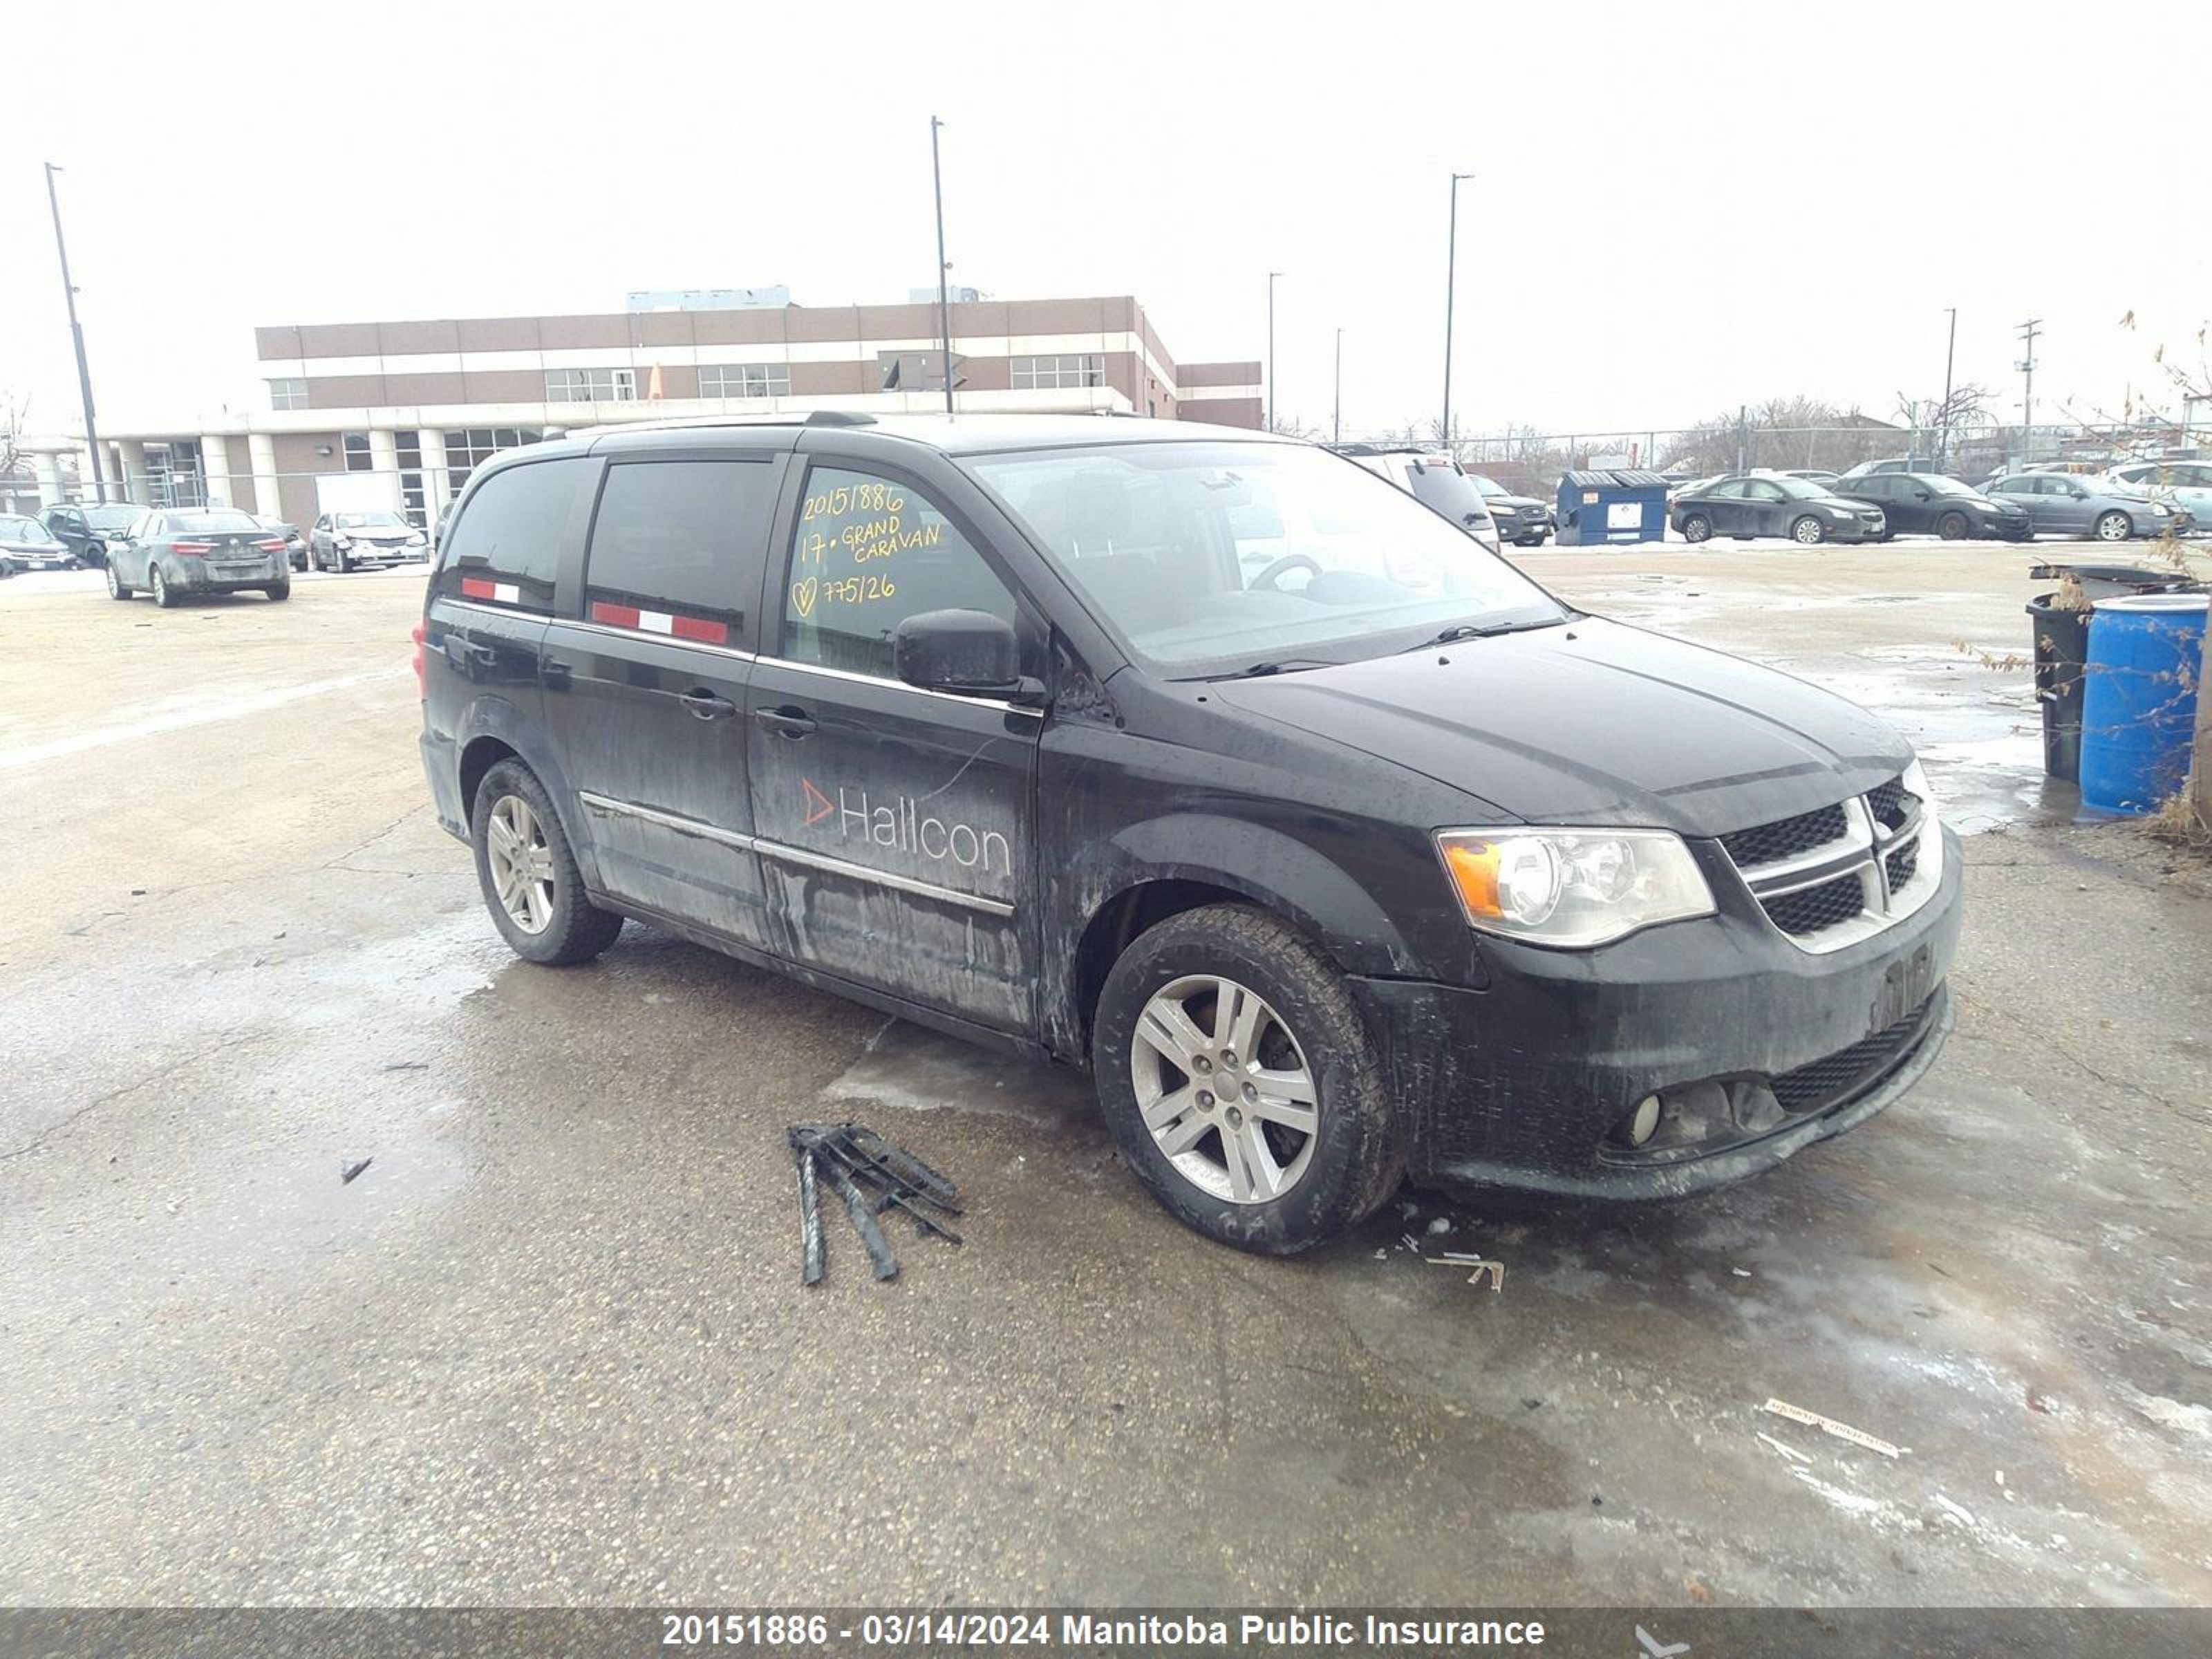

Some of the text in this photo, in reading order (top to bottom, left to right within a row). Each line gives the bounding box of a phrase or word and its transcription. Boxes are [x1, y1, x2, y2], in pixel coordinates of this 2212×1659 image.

[803, 483, 904, 521] 20151886
[841, 516, 901, 551] GRAND
[854, 523, 941, 564] CARAVAN
[839, 787, 1011, 877] Hallcon
